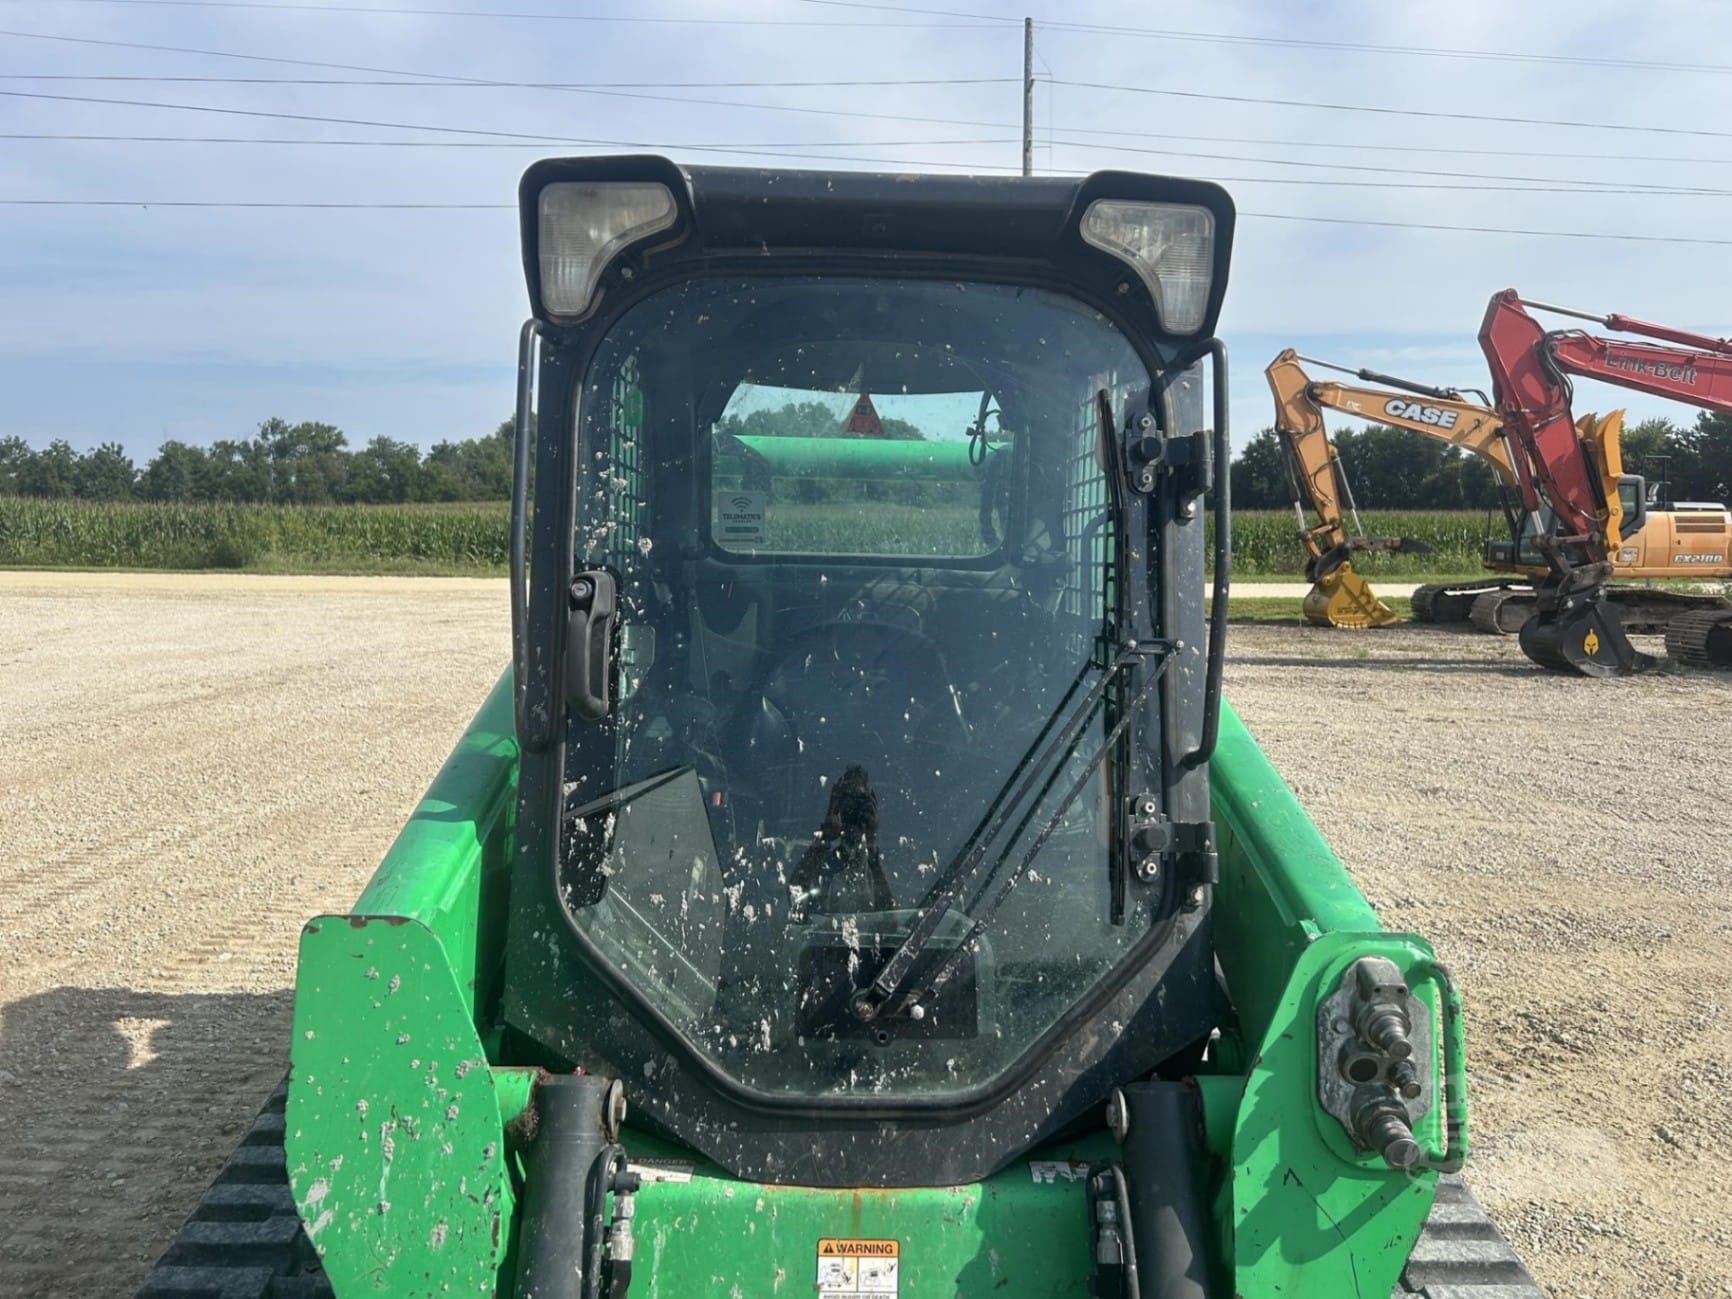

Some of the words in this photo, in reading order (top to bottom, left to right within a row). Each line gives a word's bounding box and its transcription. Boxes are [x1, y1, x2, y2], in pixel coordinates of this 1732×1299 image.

[1606, 350, 1697, 385] Link-Belt
[1384, 398, 1458, 429] CASE
[836, 1243, 893, 1255] WARNING
